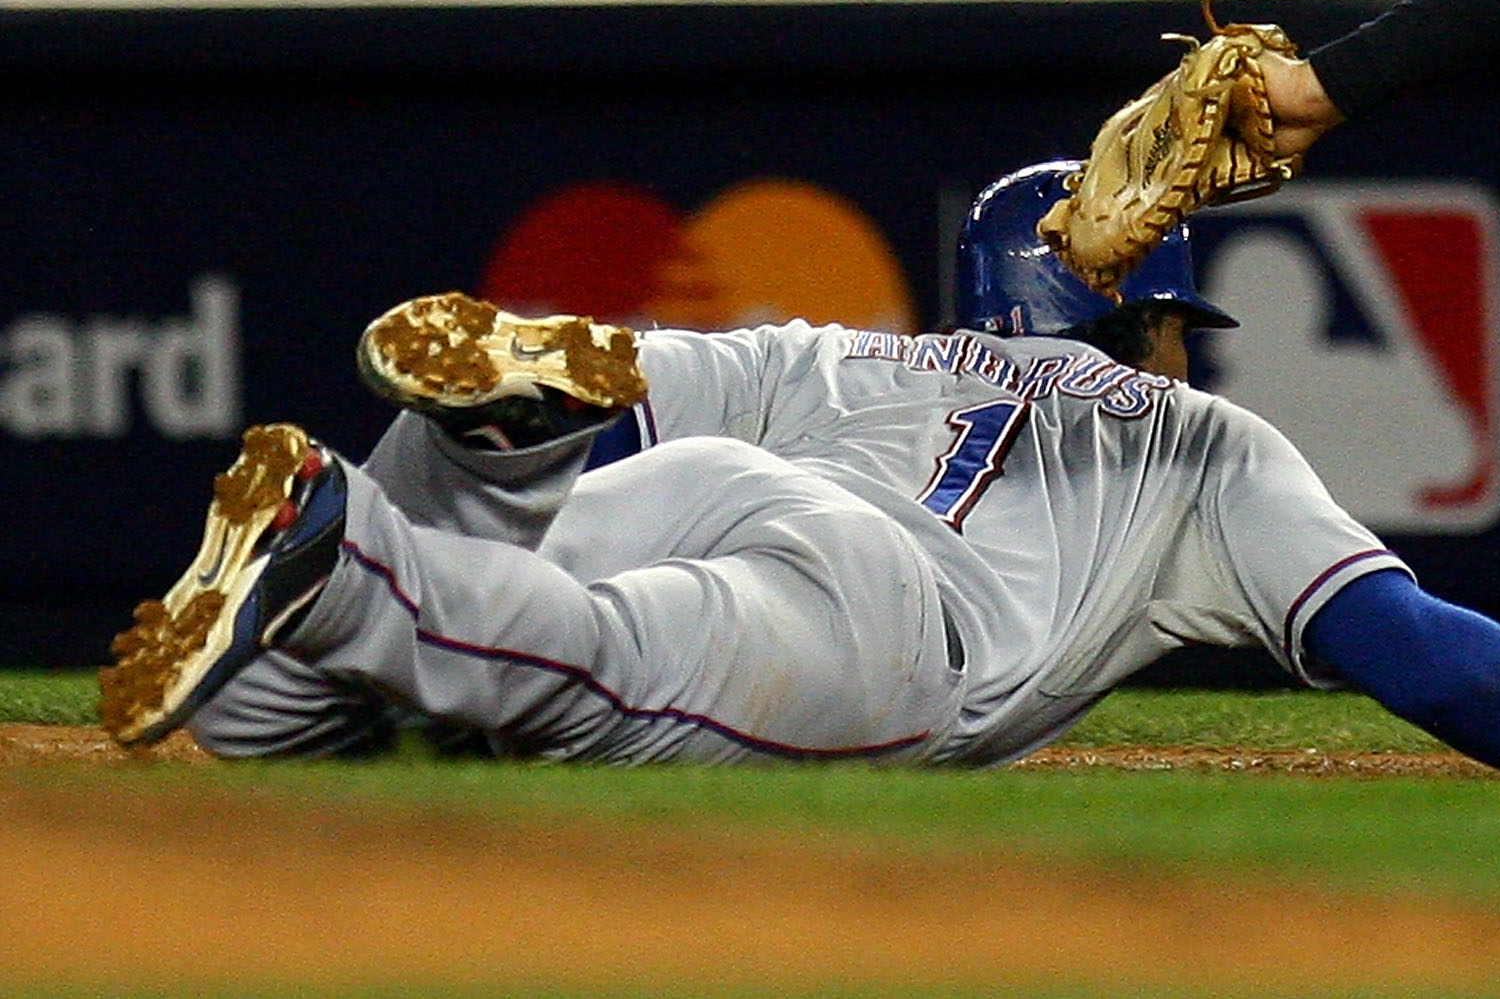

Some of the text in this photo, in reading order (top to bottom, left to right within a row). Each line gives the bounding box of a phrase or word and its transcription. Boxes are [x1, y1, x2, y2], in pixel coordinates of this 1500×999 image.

[0, 280, 240, 436] ard
[846, 328, 1172, 420] ANDRUS
[914, 399, 1032, 534] 1
